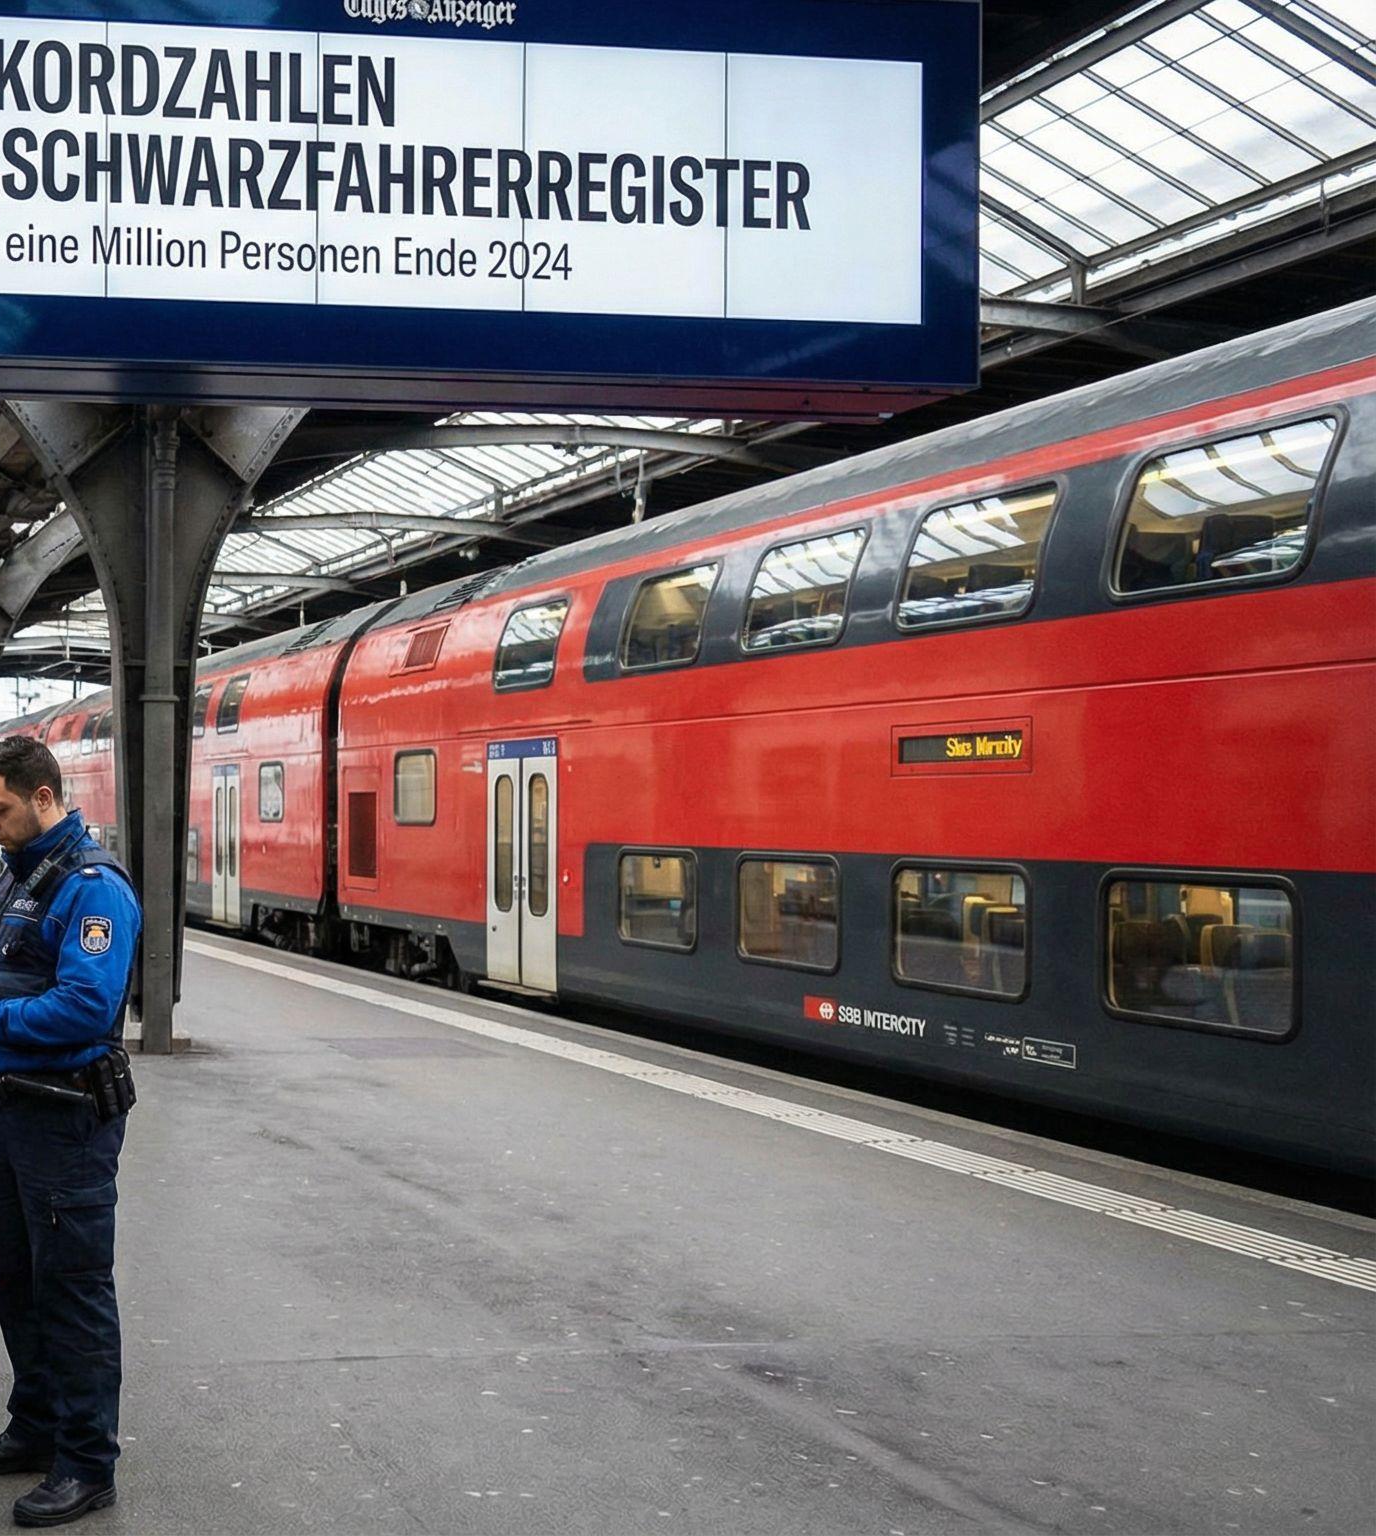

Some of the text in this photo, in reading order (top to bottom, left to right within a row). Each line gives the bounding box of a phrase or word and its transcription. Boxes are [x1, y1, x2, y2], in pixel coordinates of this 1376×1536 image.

[427, 0, 517, 30] Anzeiger
[1, 127, 811, 231] SCHWARZFAHRERREGISTER
[6, 223, 79, 264] eine
[92, 225, 206, 268] Million
[220, 230, 380, 274] Personen
[394, 236, 477, 278] Ende
[488, 240, 573, 281] 2024
[863, 1009, 926, 1038] INTERCITY
